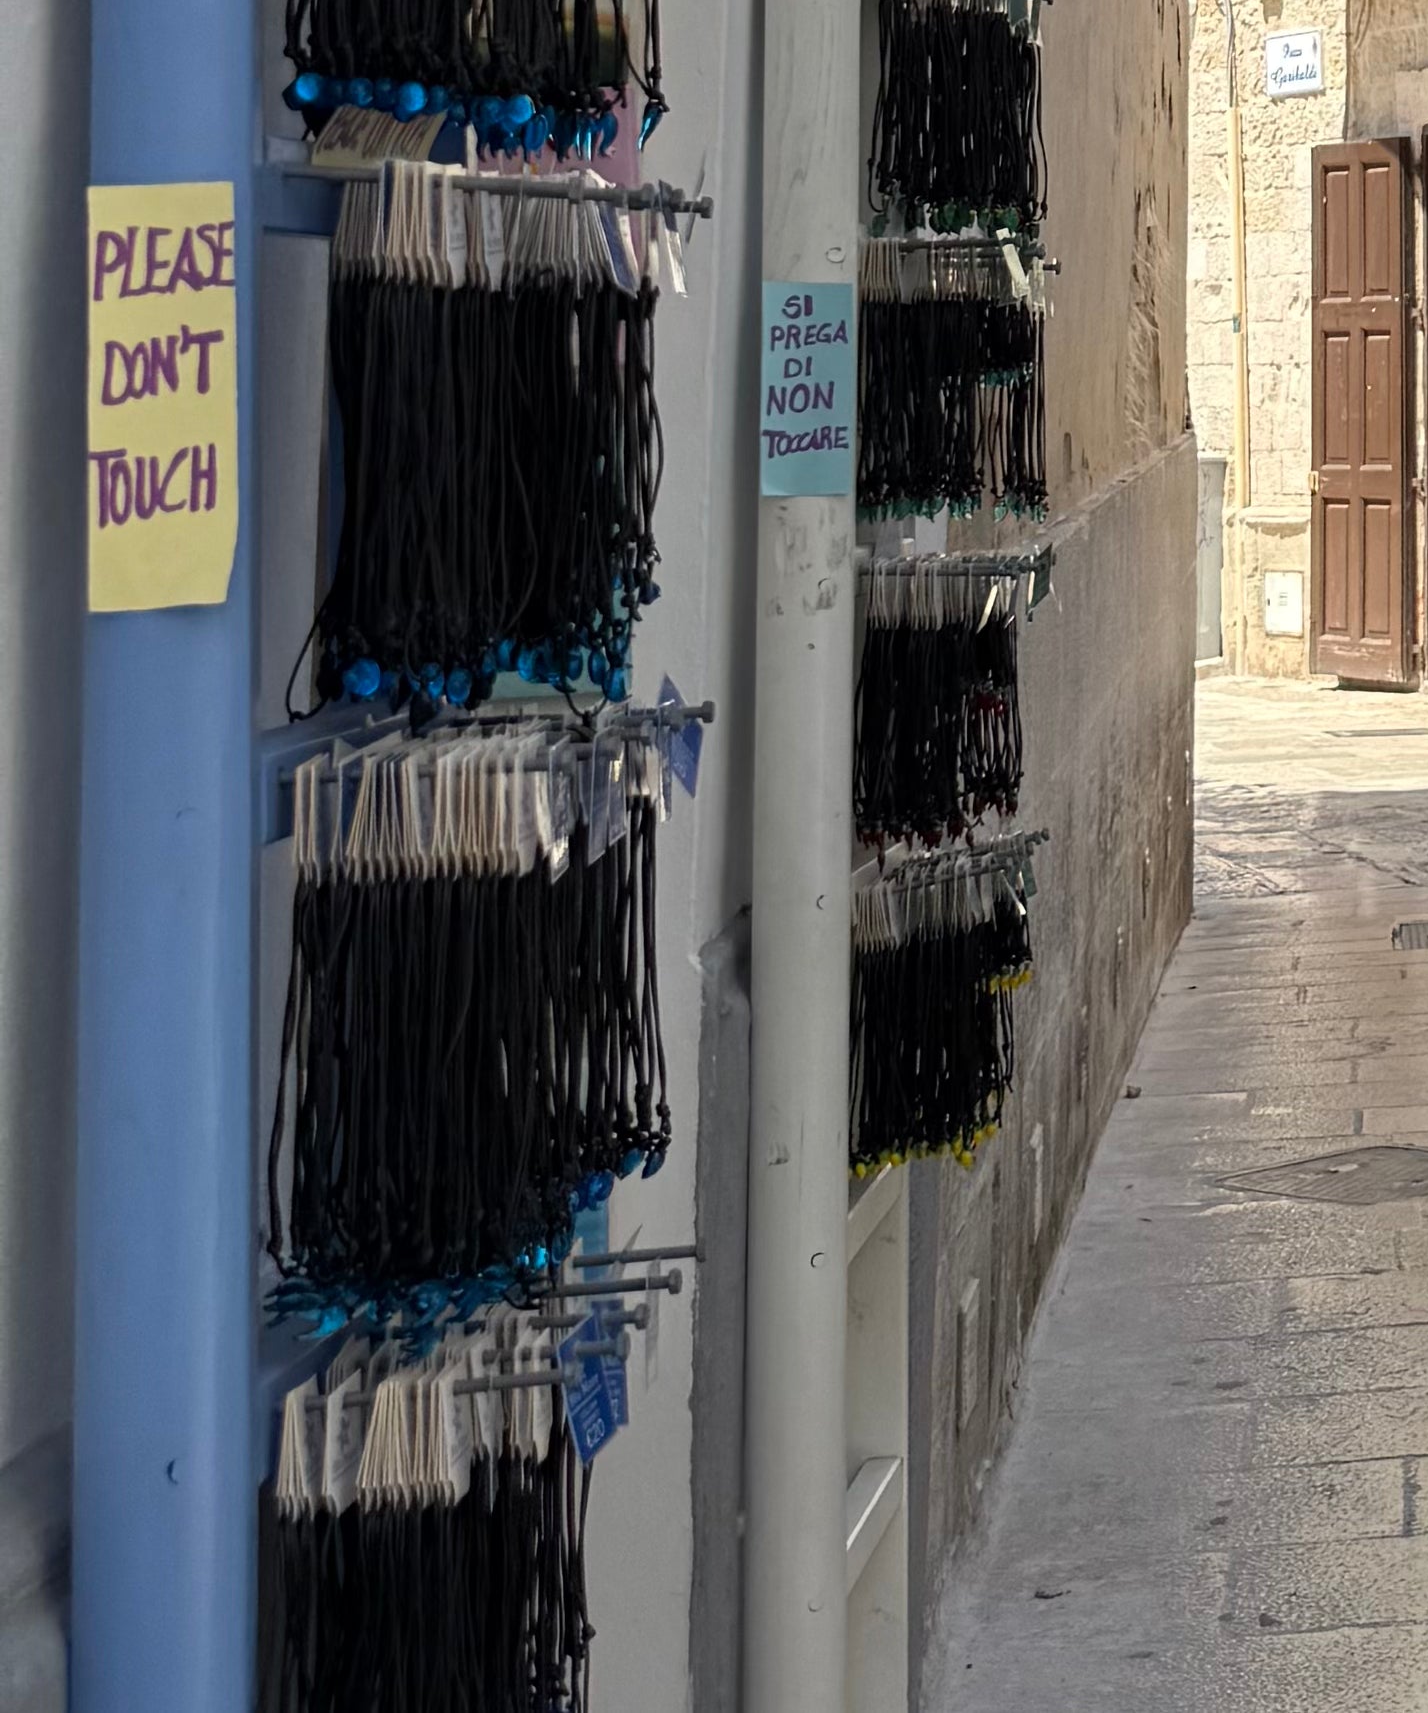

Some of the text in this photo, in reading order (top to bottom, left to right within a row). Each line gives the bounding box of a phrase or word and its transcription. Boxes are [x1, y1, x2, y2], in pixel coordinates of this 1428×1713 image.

[93, 219, 236, 302] PLEASE
[781, 294, 814, 320] SI
[769, 319, 849, 352] PREGA
[101, 324, 225, 406] DON'T
[783, 355, 813, 379] DI
[766, 380, 836, 417] NON
[761, 425, 850, 459] TOCCARE
[88, 442, 217, 529] TOUCH
